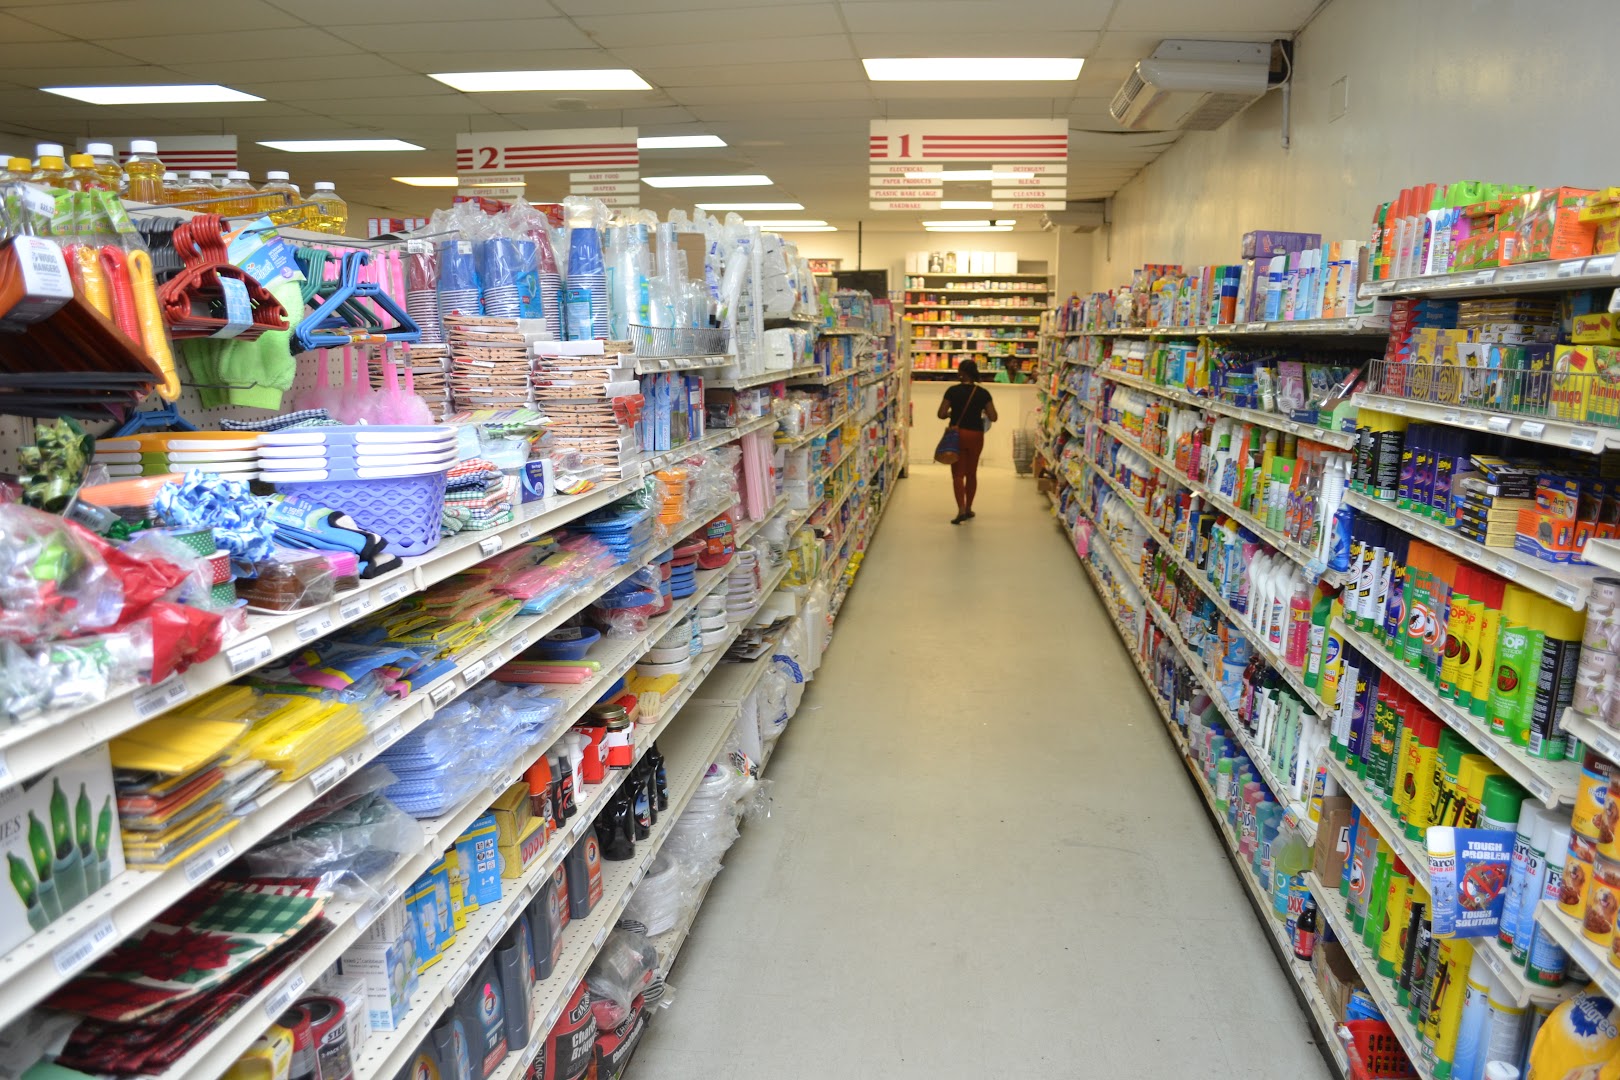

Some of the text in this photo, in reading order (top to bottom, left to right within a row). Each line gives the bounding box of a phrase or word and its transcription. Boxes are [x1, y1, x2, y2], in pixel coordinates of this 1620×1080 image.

[898, 134, 912, 158] 1
[478, 146, 499, 169] 2
[1467, 841, 1503, 852] TOUGH
[1461, 850, 1511, 861] PROBLEM
[1428, 856, 1455, 868] Farco
[1461, 910, 1493, 920] TOUGH
[1455, 917, 1499, 928] SOLUTION
[1571, 990, 1618, 1039] Pedigree
